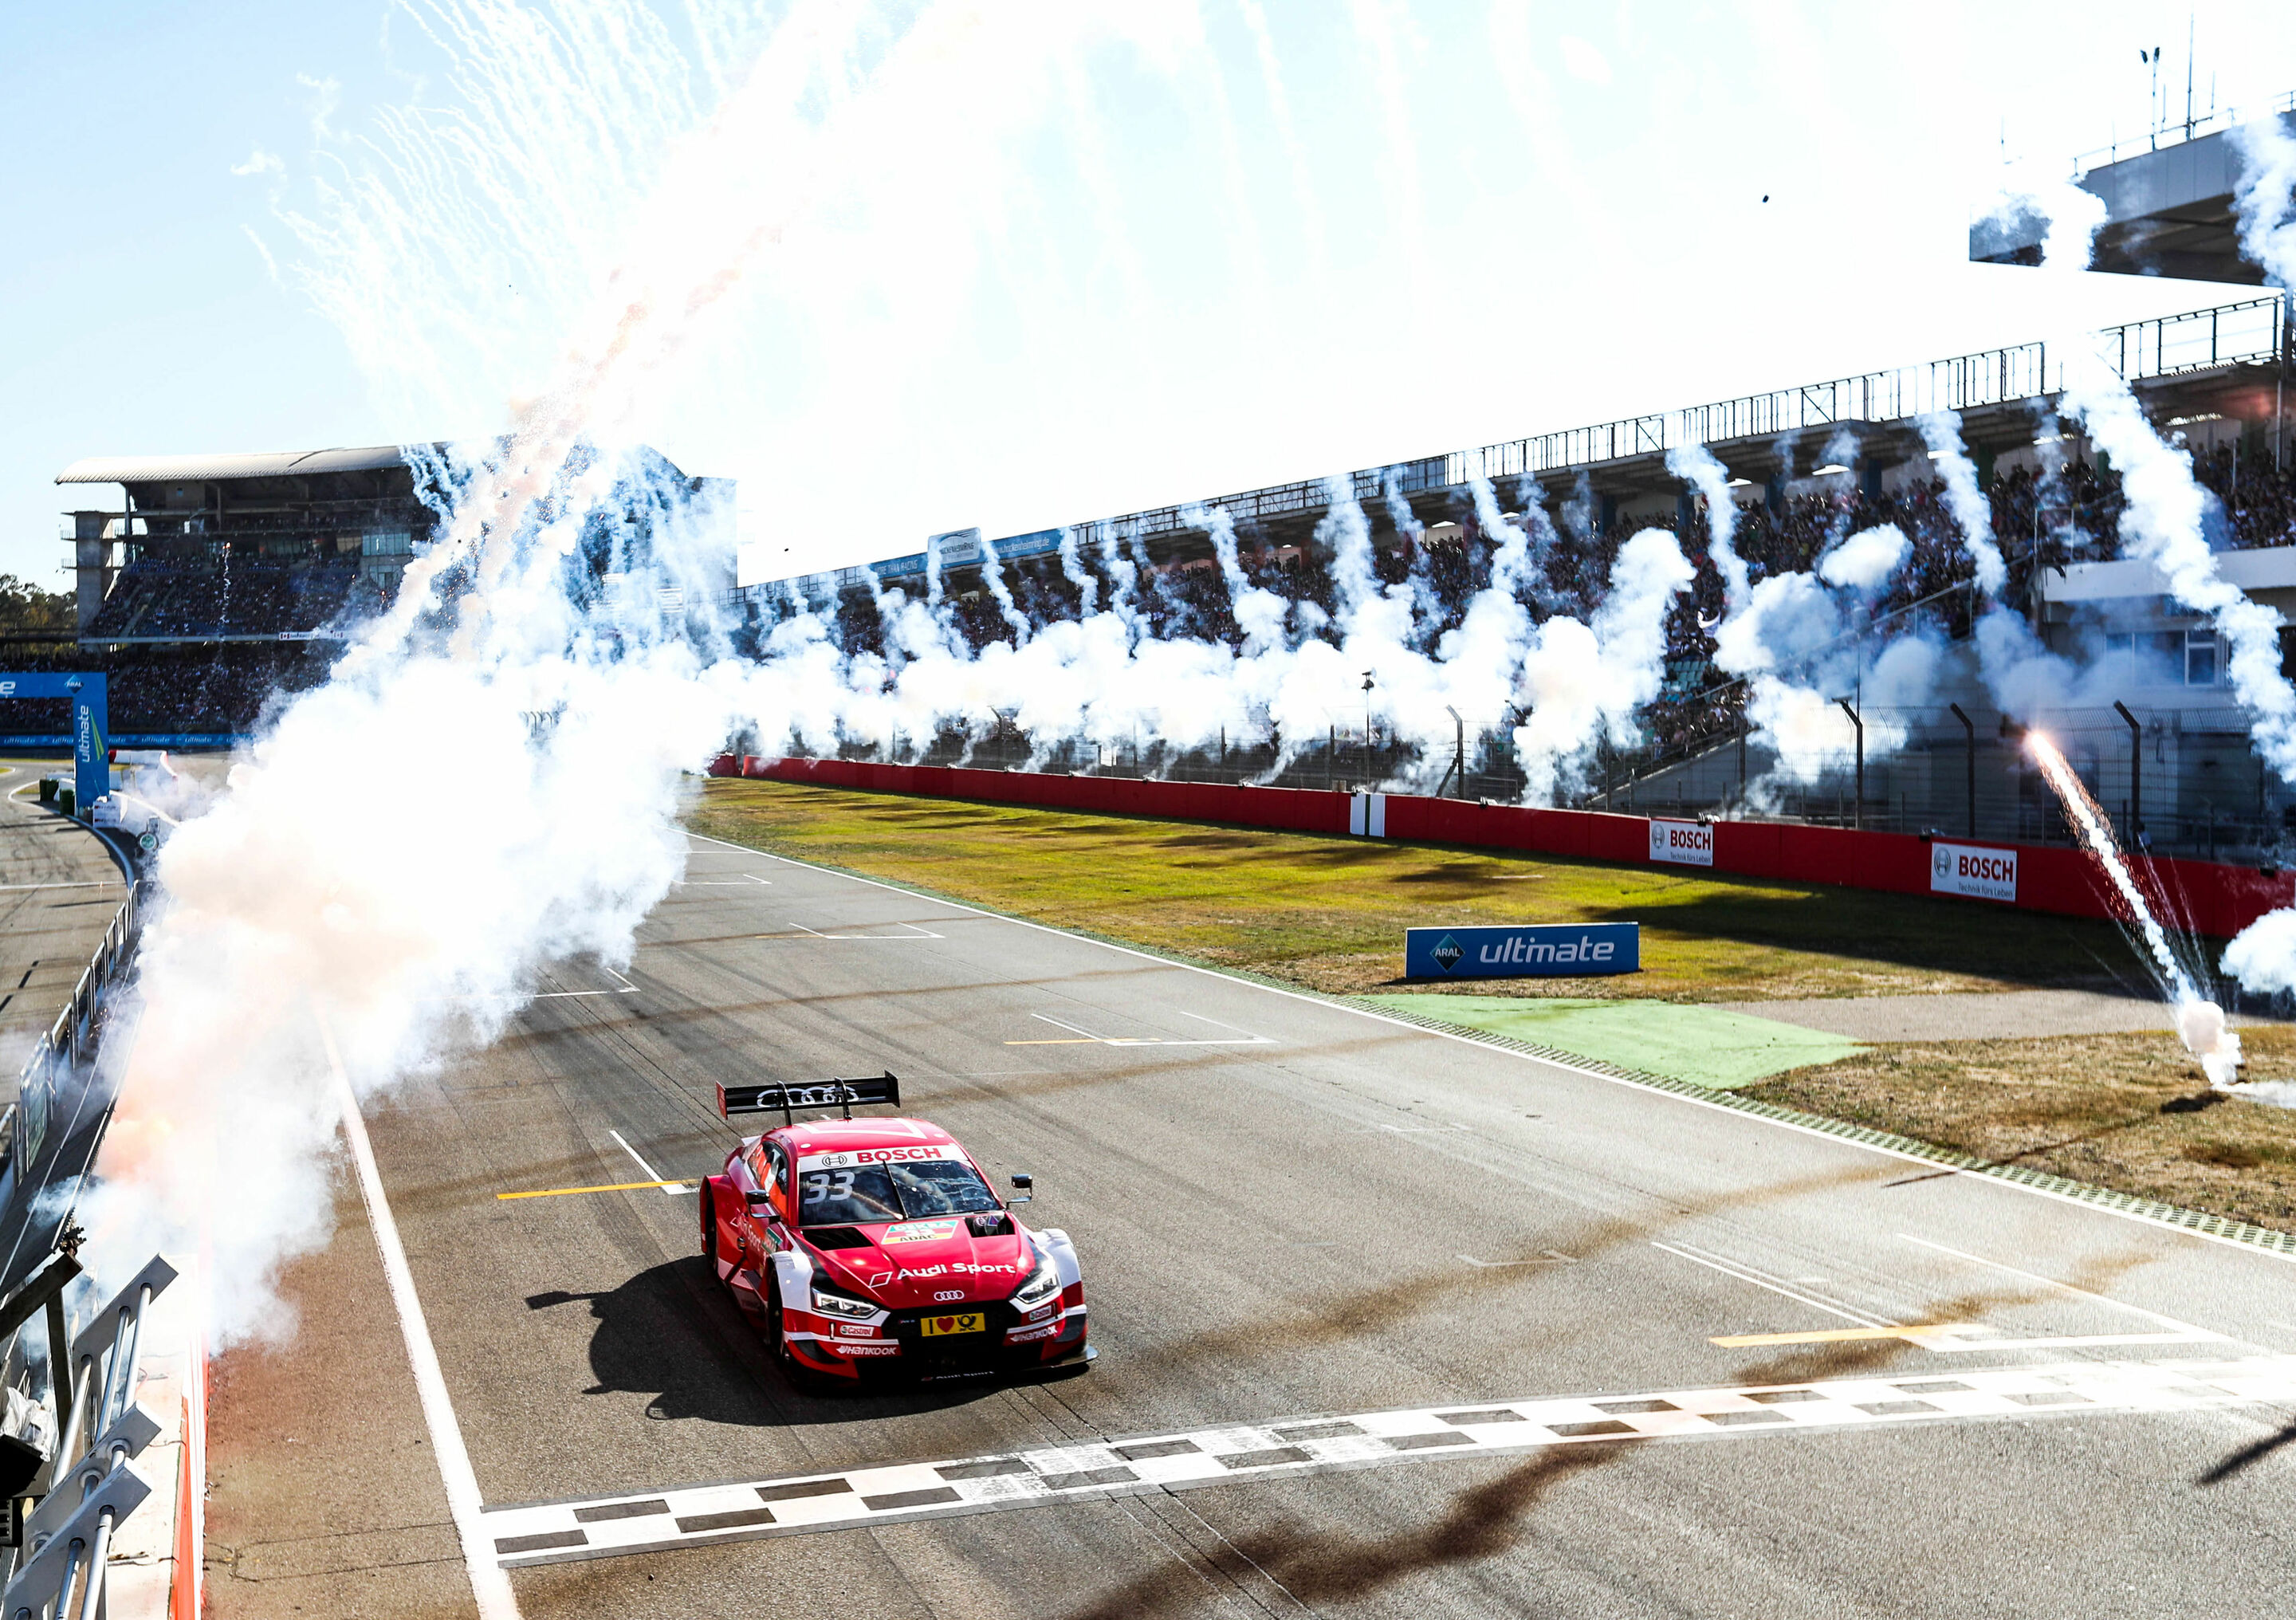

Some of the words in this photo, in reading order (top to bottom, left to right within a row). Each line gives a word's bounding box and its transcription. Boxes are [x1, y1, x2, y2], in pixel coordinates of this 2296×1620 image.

[78, 705, 90, 763] ultimate
[1670, 829, 1711, 851] BOSCH
[1959, 855, 2013, 883] BOSCH
[1435, 947, 1460, 957] ARAL
[1480, 935, 1614, 963] ultimate
[856, 1147, 942, 1164] BOSCH
[804, 1171, 855, 1205] 33
[897, 1264, 948, 1280] Audi
[951, 1263, 1016, 1274] Sport
[847, 1327, 871, 1335] Castrol
